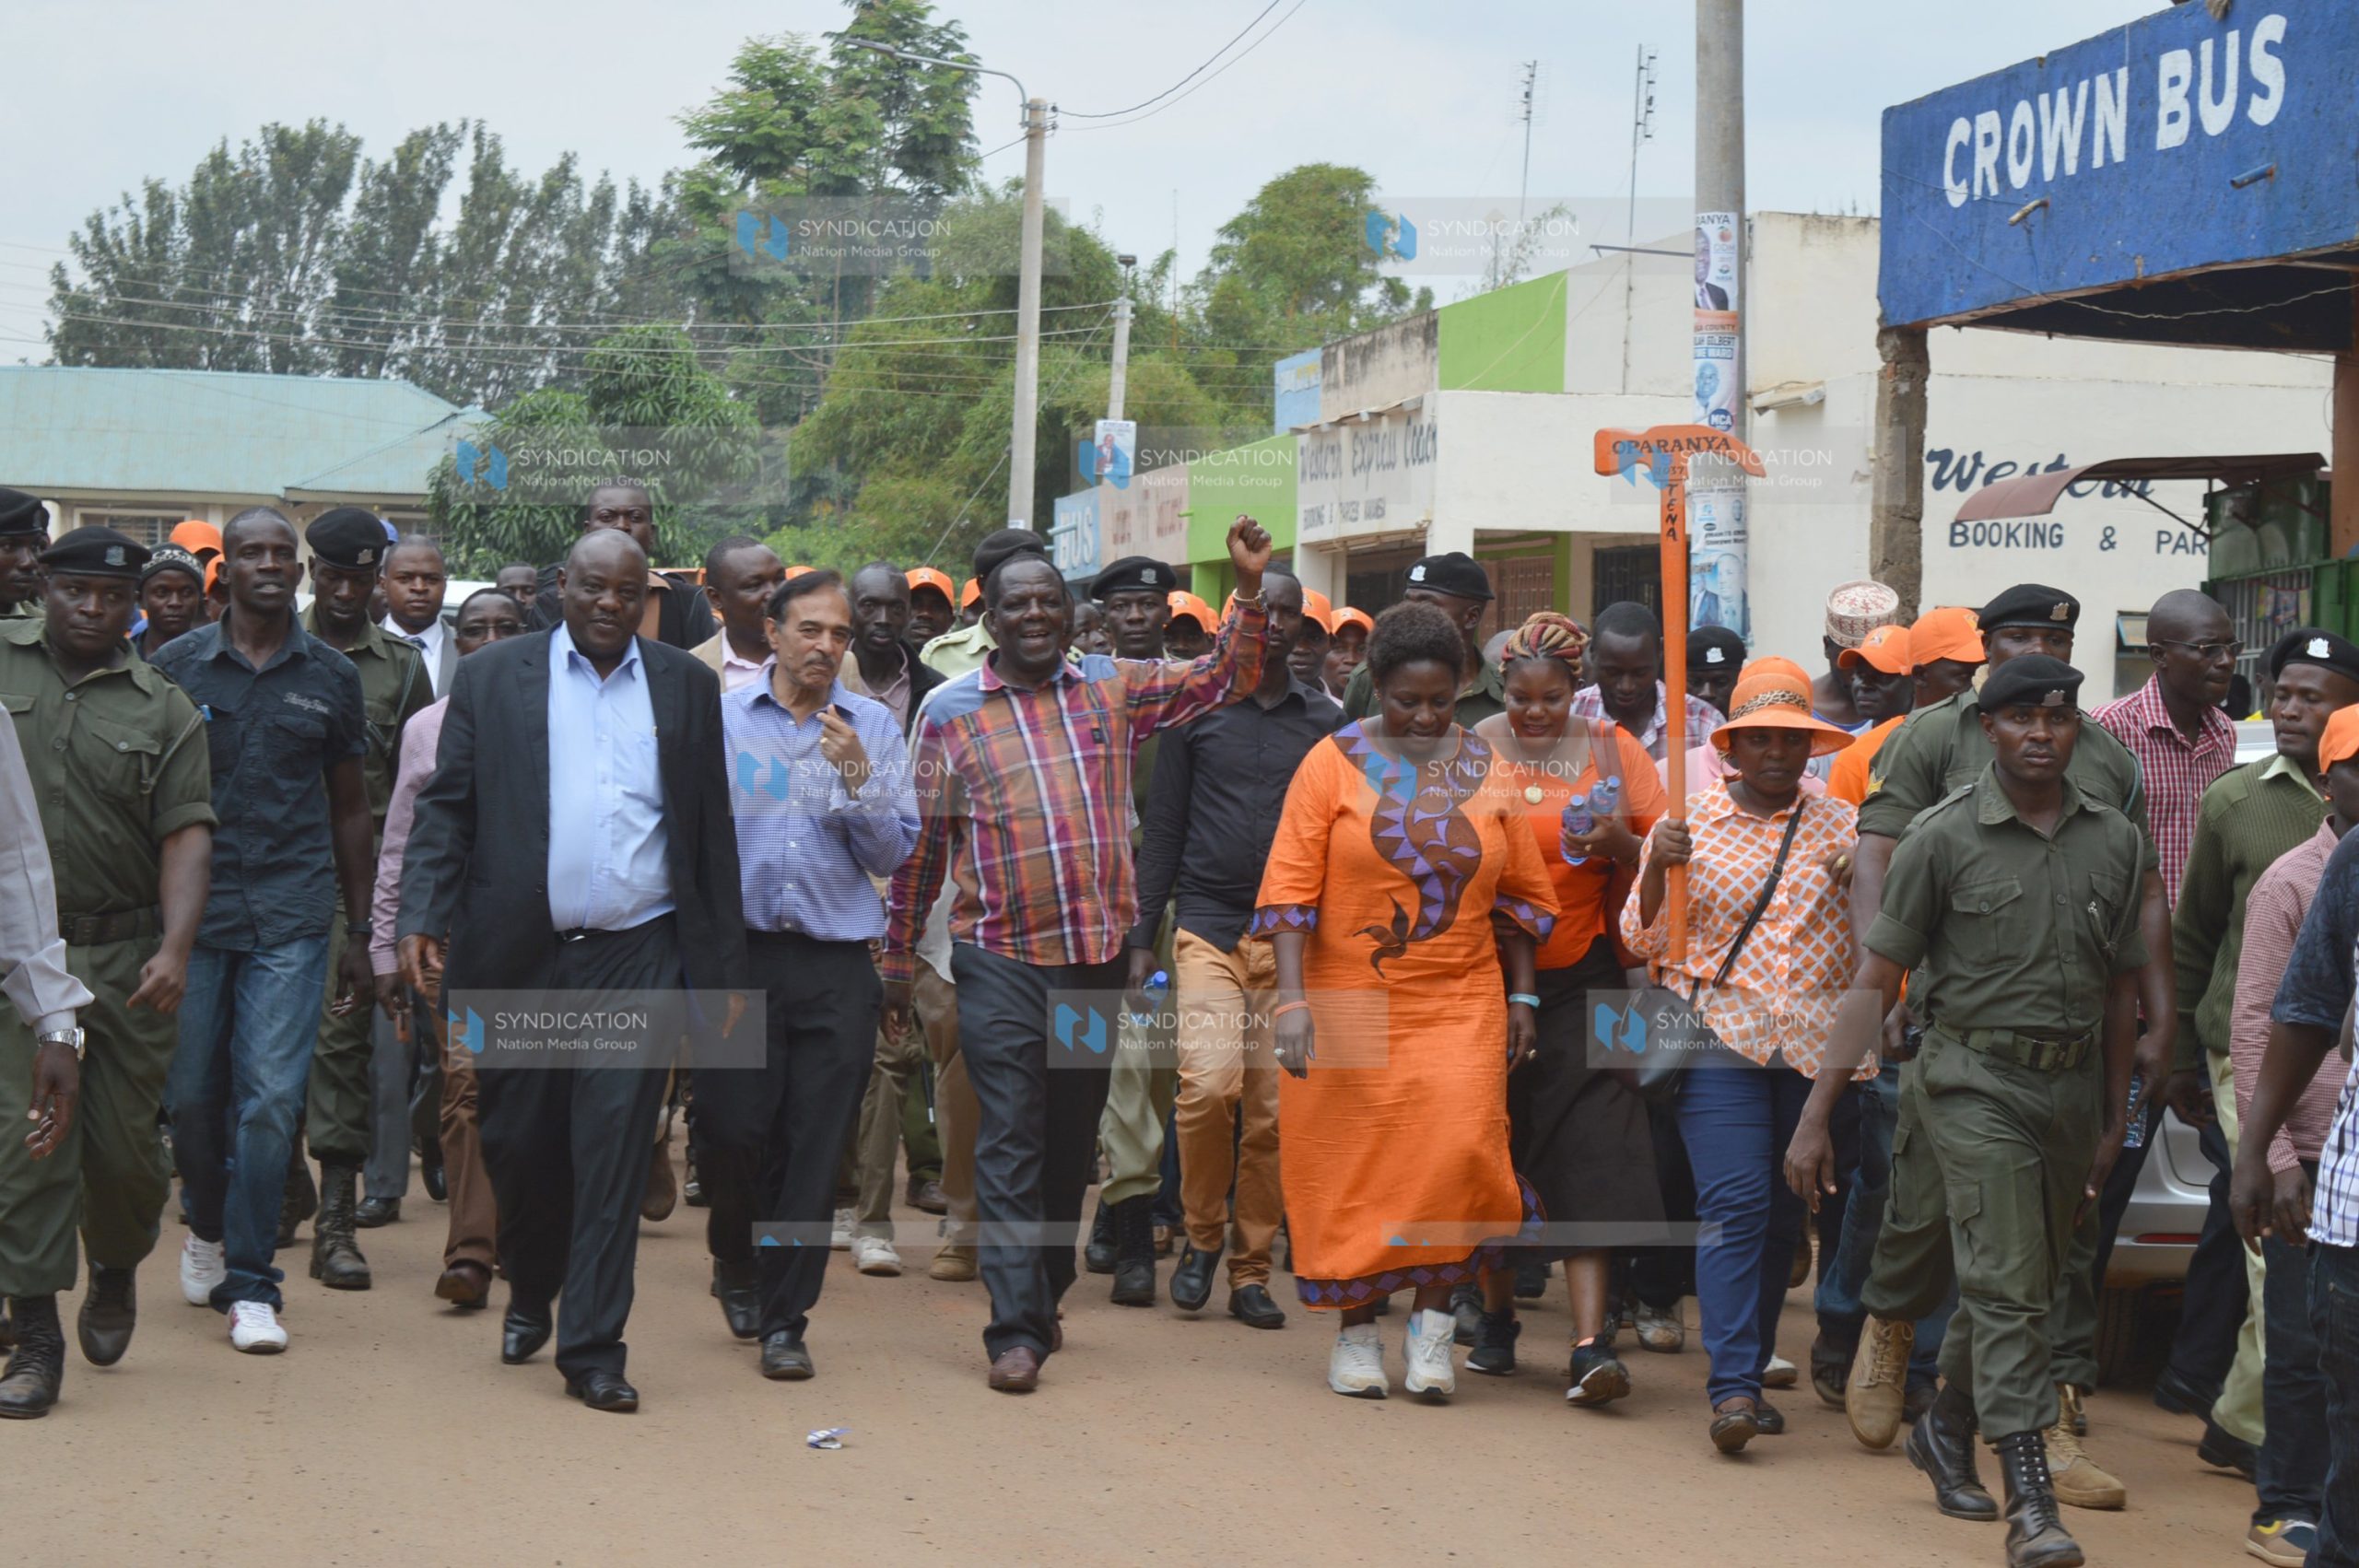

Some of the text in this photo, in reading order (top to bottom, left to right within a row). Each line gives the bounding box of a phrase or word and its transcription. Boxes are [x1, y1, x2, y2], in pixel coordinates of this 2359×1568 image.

[1943, 14, 2287, 208] CROWN BUS
[1710, 414, 1732, 425] MCA
[1612, 436, 1731, 454] OPARANYA
[1666, 484, 1678, 542] TENA
[1949, 521, 2064, 548] BOOKING
[2099, 526, 2117, 551] &
